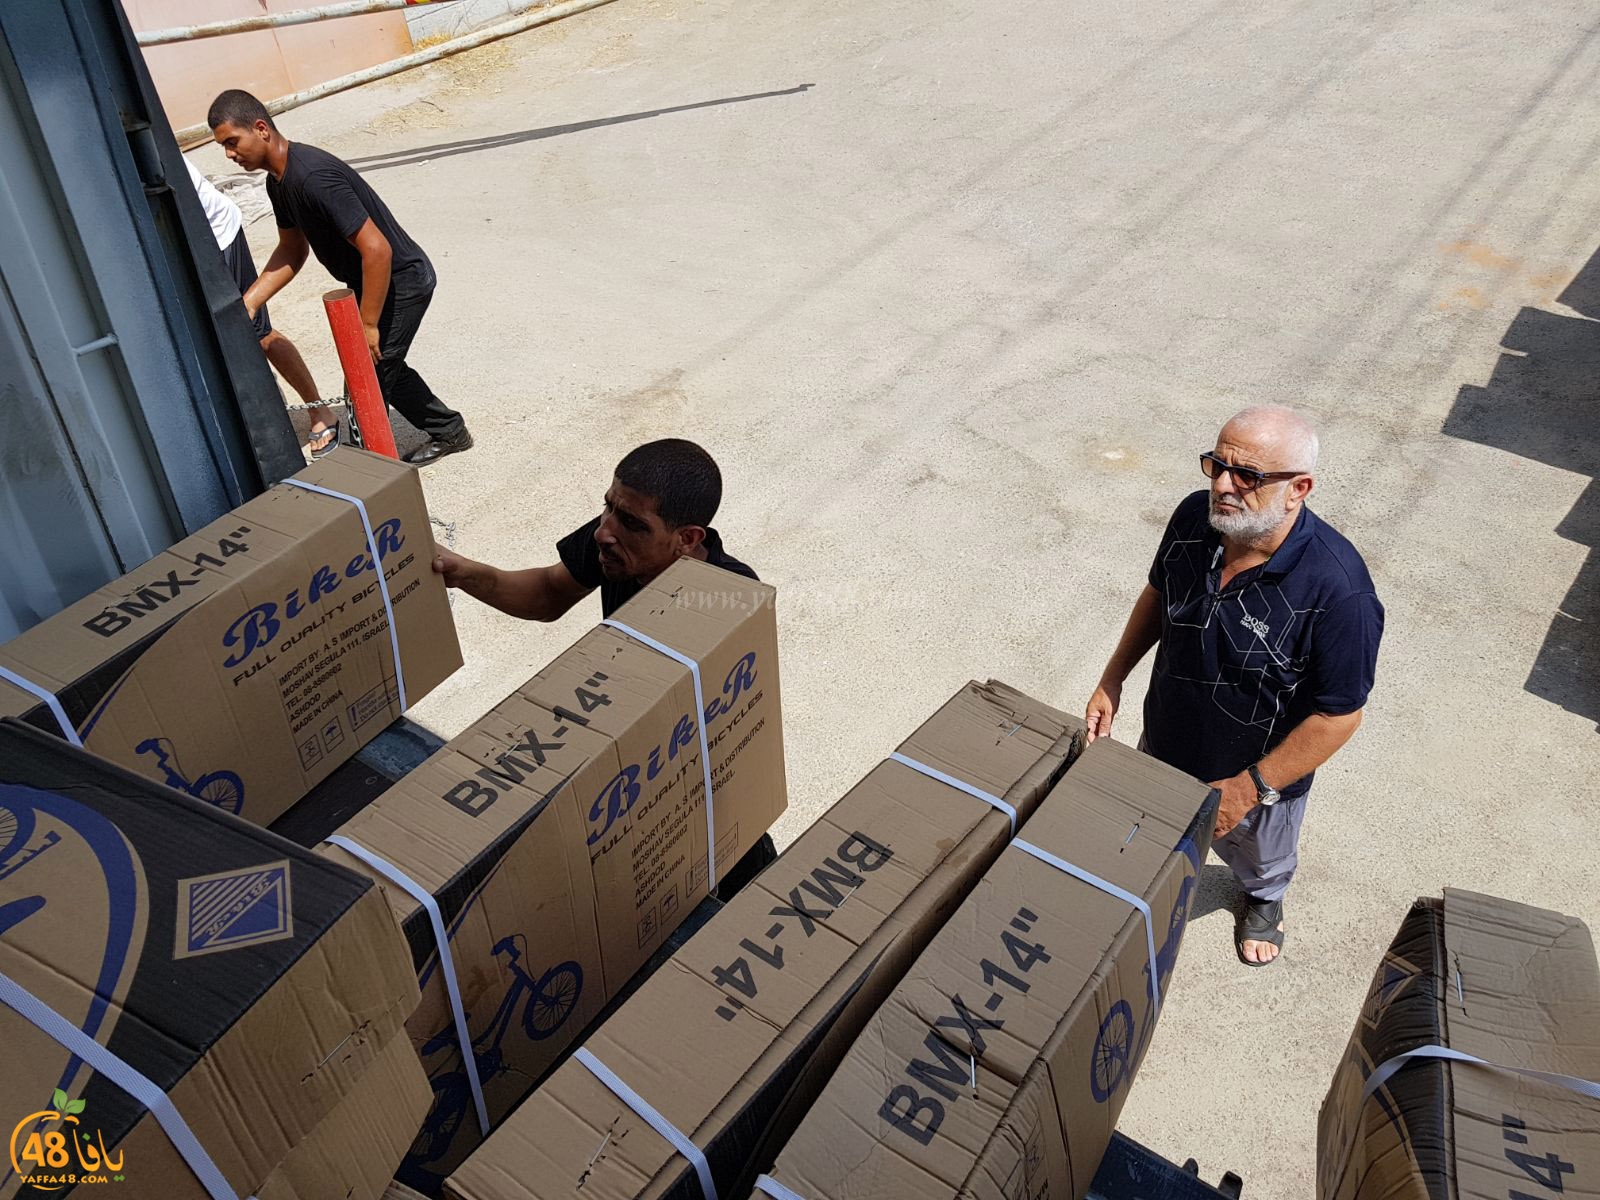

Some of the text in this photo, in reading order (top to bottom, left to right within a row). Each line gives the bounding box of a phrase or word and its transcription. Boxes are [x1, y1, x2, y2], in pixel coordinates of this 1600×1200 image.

[82, 526, 252, 638] BMX-14"
[279, 658, 307, 686] IMPORT
[339, 617, 370, 641] IMPORT
[371, 613, 378, 622] &
[378, 578, 421, 618] DIRIBUTION
[1243, 613, 1270, 634] BOSS
[233, 655, 277, 686] FULL
[280, 602, 346, 653] QUALITY
[282, 667, 314, 698] MOSHAV
[314, 647, 346, 673] SEGULA
[362, 620, 390, 642] ISRAEL
[290, 693, 321, 723] ASHDOD
[293, 712, 314, 734] MADE
[321, 689, 344, 710] CHINA
[442, 672, 613, 818] BMX-14"
[591, 689, 763, 866] FULL QUALITY BICYCLES
[631, 823, 660, 859] IMPORT
[724, 717, 765, 768] DISTRIBUTION
[632, 835, 664, 873] MOSHAV
[664, 805, 693, 839] SEGULA
[711, 769, 736, 794] SRAEL
[635, 861, 666, 898] ASHDOD
[635, 884, 656, 910] MADE
[664, 854, 686, 879] CHINA
[711, 830, 895, 1022] BMX-14"
[877, 907, 1052, 1147] BMX-14"
